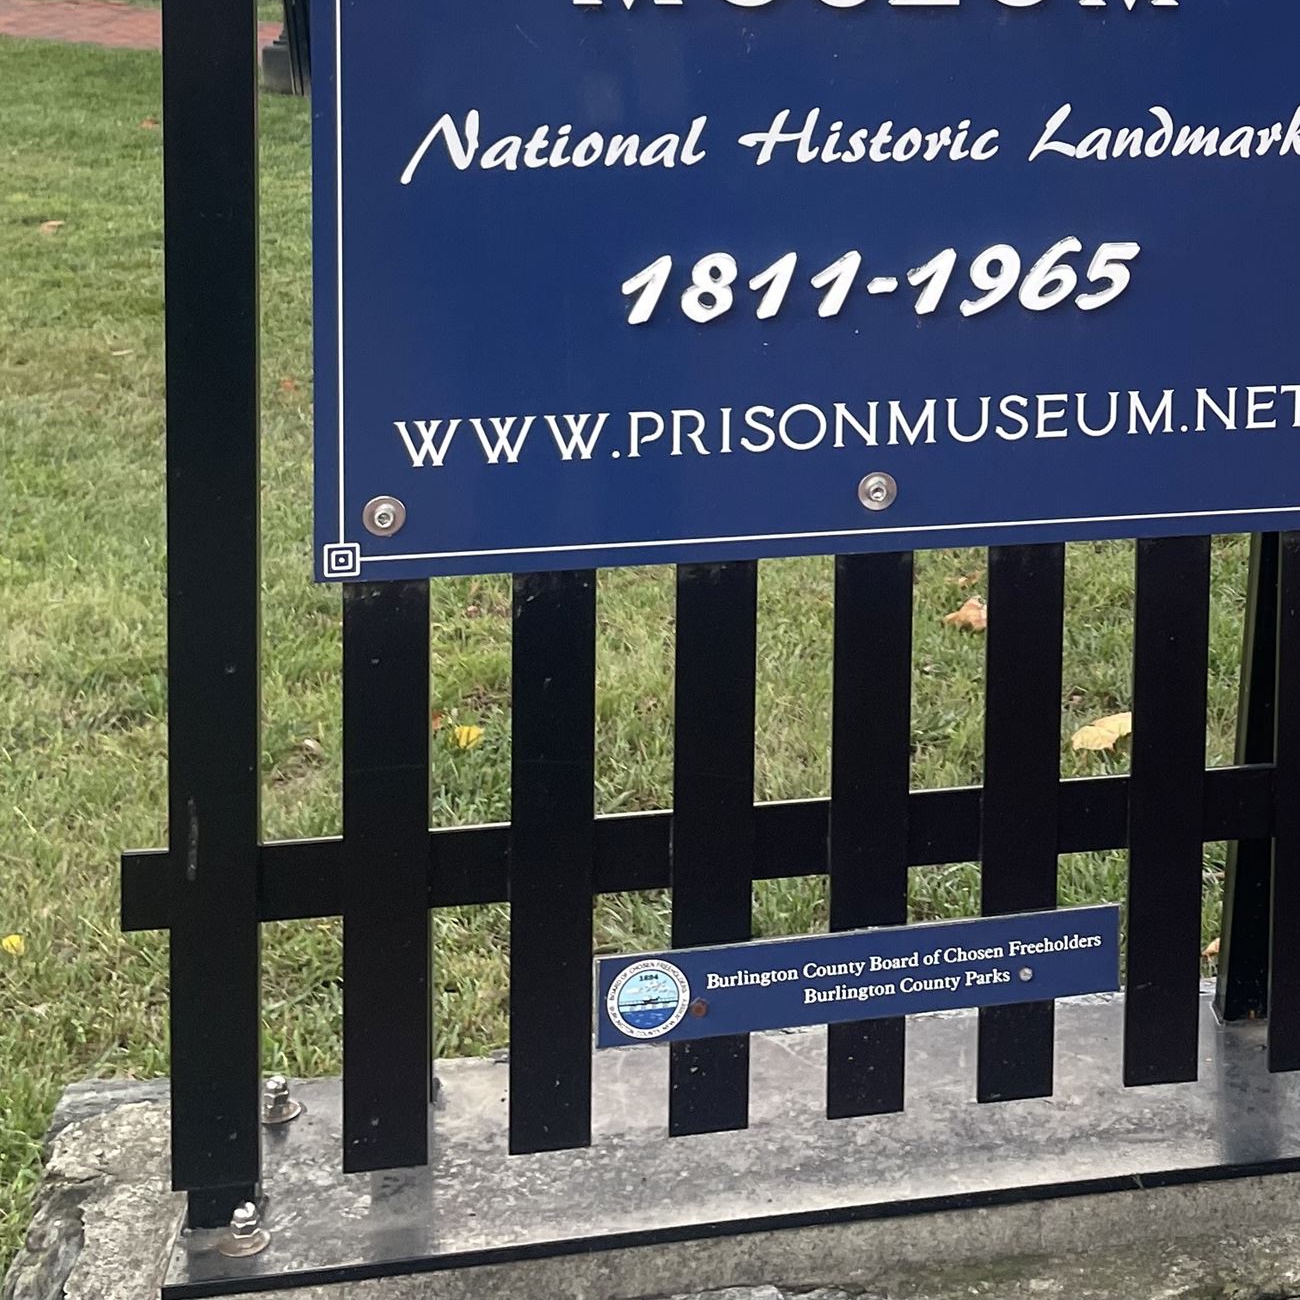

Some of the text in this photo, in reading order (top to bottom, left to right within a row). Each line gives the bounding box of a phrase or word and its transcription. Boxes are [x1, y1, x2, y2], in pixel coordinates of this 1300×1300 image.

[400, 109, 707, 185] National
[737, 107, 999, 166] Historic
[621, 235, 1141, 325] 1811-1965
[706, 932, 1103, 990] Burlington County Board of Chosen Freeholders
[803, 967, 1011, 1004] Burlington County Parks
